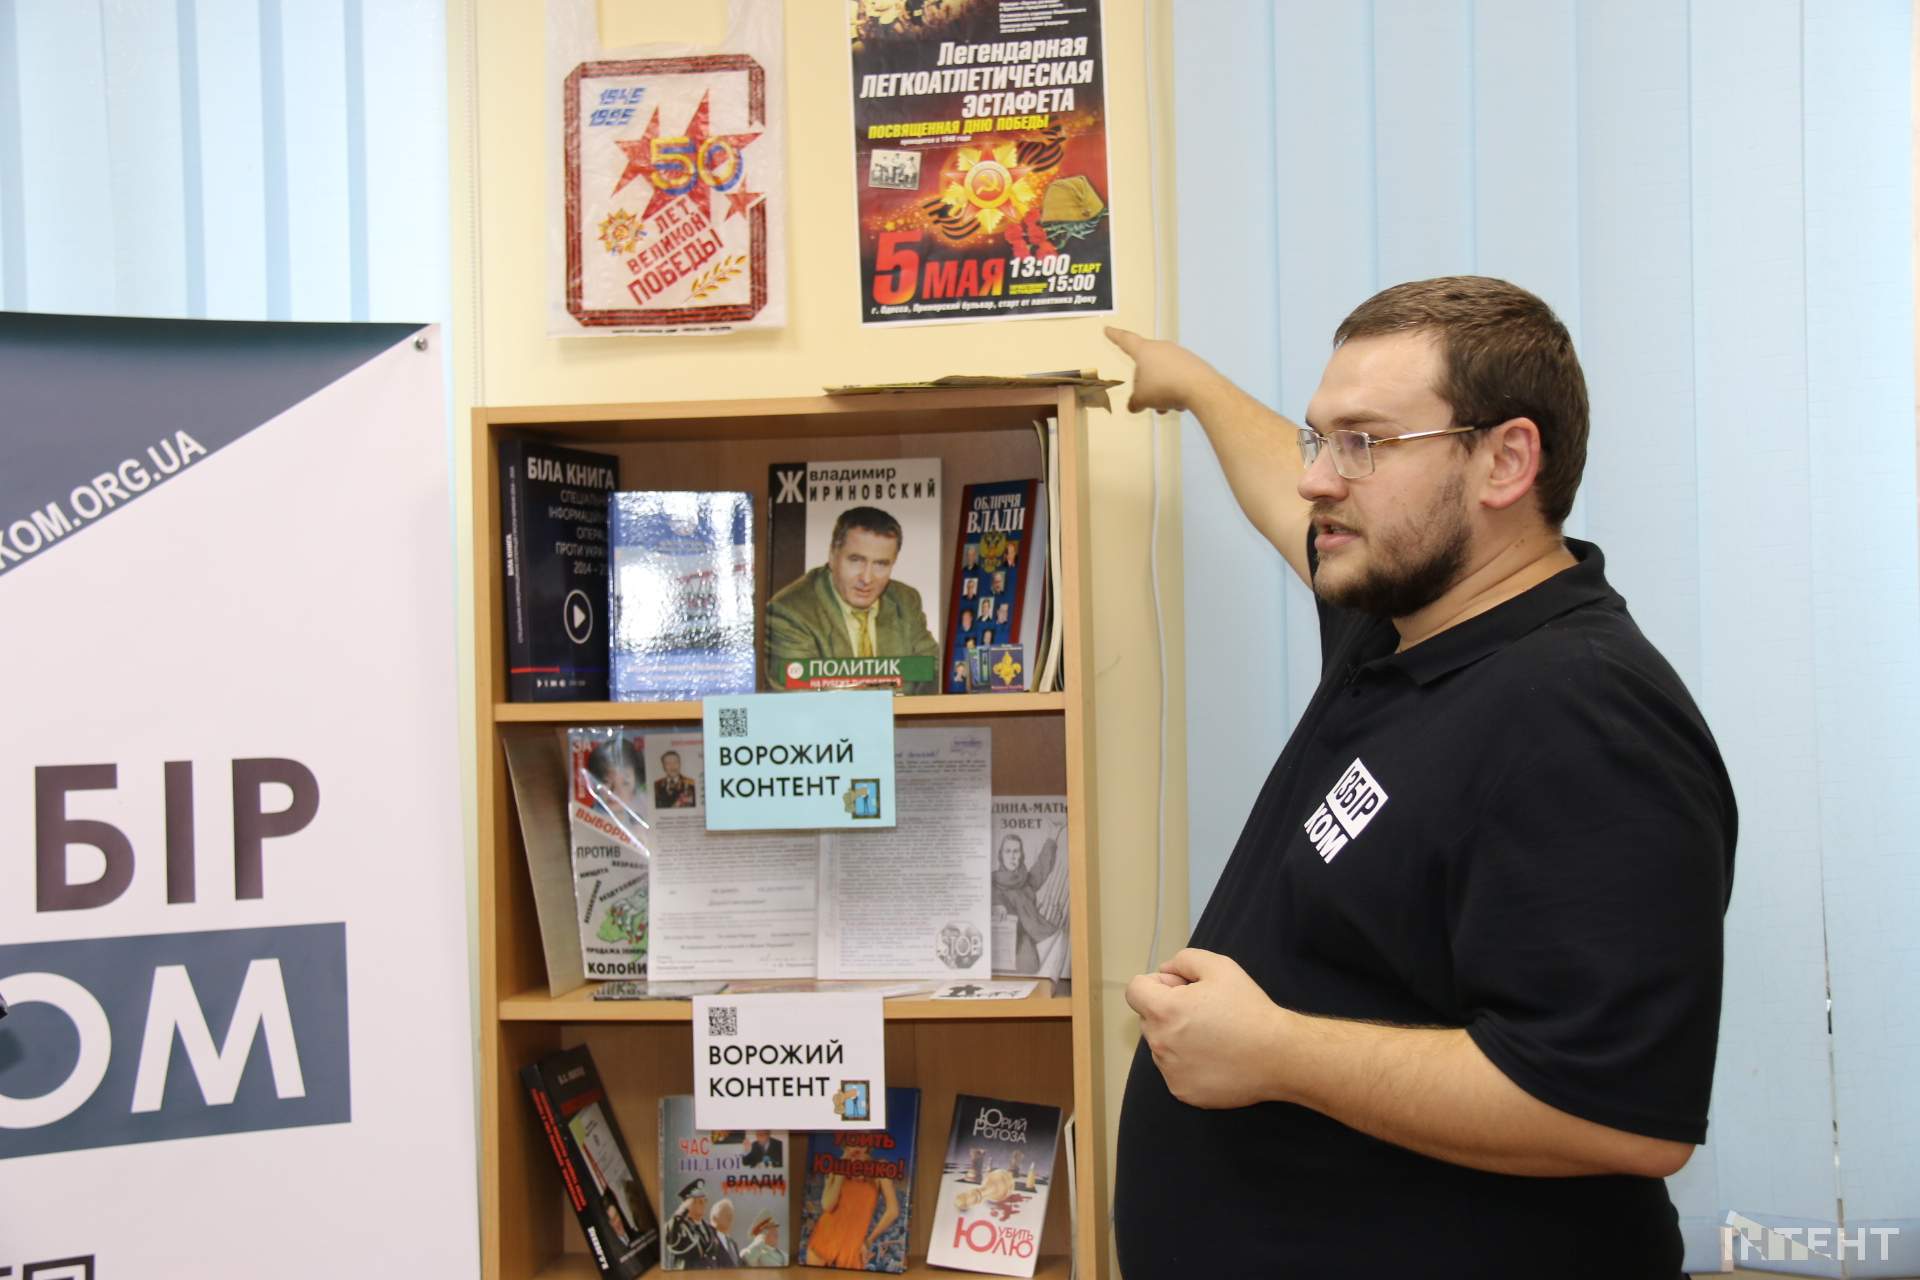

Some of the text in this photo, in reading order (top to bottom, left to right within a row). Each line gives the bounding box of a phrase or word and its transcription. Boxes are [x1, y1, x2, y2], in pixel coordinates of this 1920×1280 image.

[937, 37, 1088, 66] Легендарная
[860, 60, 1095, 98] ЛЕГКОАТЛЕТИЧЕСКАЯ
[961, 88, 1075, 118] ЭСТАФЕТА
[868, 114, 1050, 139] ПОСВЯЩЕННАЯ ДНЮ ПОБЕДЫ
[650, 136, 743, 196] 50
[655, 197, 693, 234] ЛЕТ
[627, 213, 707, 275] ВЕЛИКОЙ
[627, 228, 724, 305] ПОБЕДЫ
[872, 228, 1005, 305] 5 МАЯ
[1008, 253, 1102, 278] 13:00 СТАРТ
[1046, 274, 1096, 293] 15:00
[527, 457, 616, 489] БІЛА КНИГА
[809, 467, 897, 482] владимир
[967, 507, 1026, 534] ВЛАДИ
[810, 659, 901, 676] ПОЛИТИК
[720, 738, 854, 766] ВОРОЖИЙ
[720, 776, 841, 798] КОНТЕНТ
[35, 757, 321, 913] БІР
[1000, 817, 1042, 829] ЗОВЕТ
[1303, 801, 1349, 864] КОМ
[576, 846, 622, 859] ПРОТИВ
[709, 1039, 844, 1066] ВОРОЖИЙ
[709, 1077, 830, 1098] КОНТЕНТ
[972, 1118, 1027, 1143] РОГОЗА
[680, 1136, 711, 1156] ЧАС
[725, 1173, 784, 1190] ВЛАДИ
[998, 1226, 1034, 1241] УБИТЬ
